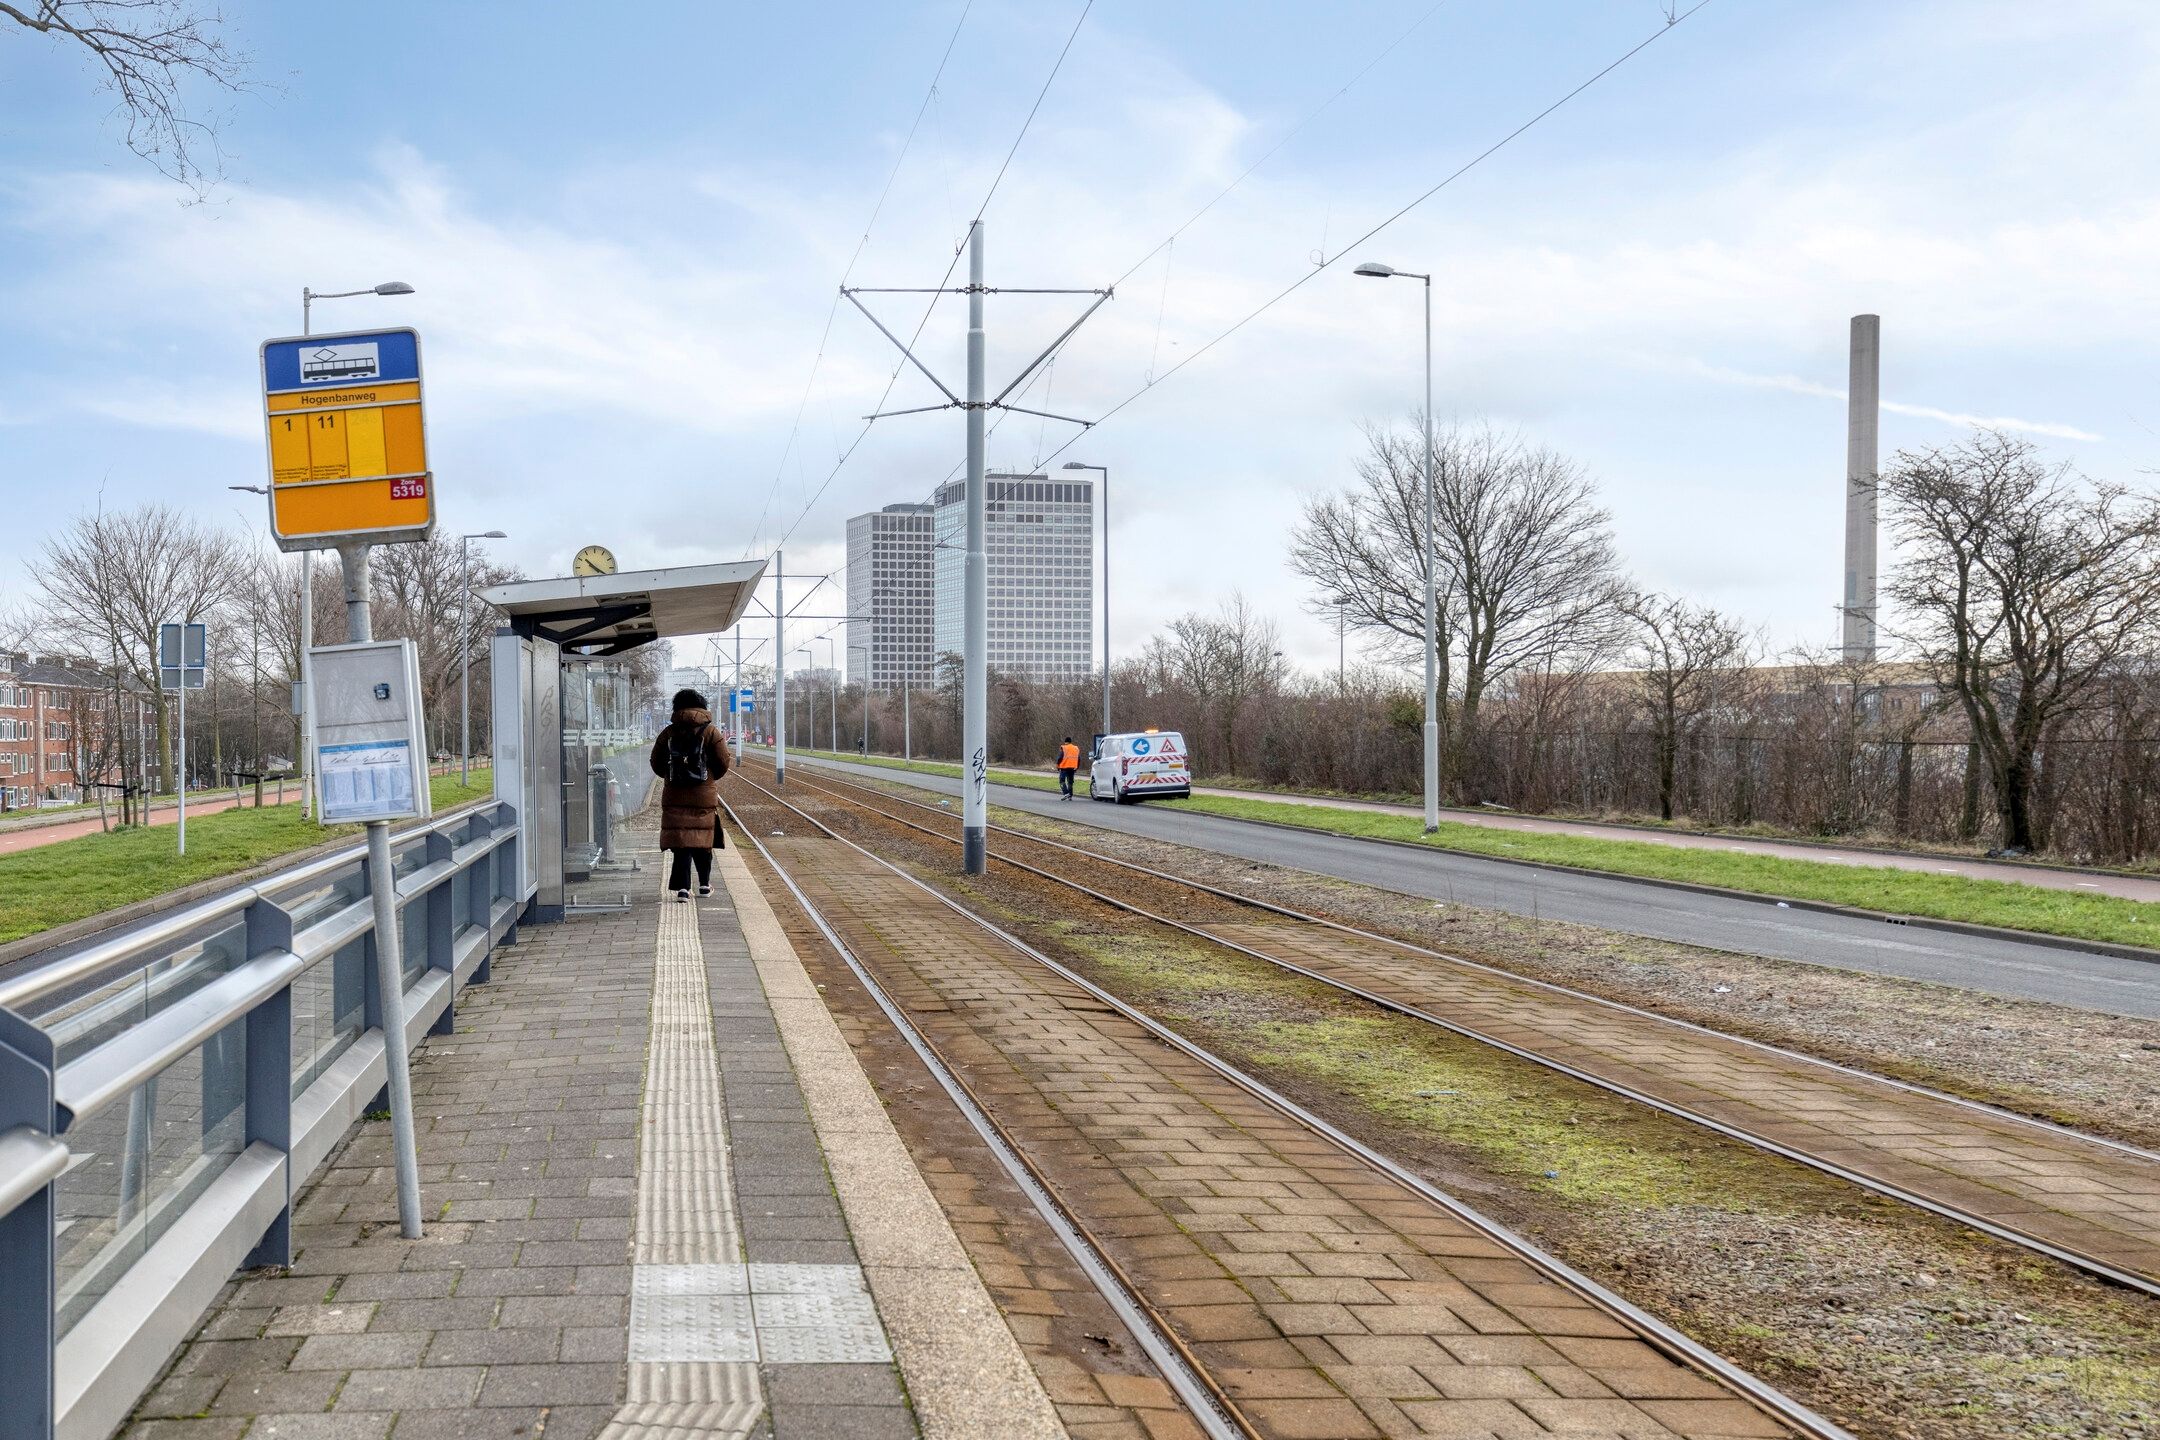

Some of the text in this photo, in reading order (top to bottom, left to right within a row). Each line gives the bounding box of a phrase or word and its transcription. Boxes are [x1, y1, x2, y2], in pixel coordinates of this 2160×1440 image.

[301, 392, 376, 405] Hogenbanweg
[284, 418, 291, 432] 1
[317, 414, 334, 429] 11
[392, 484, 424, 498] 5319
